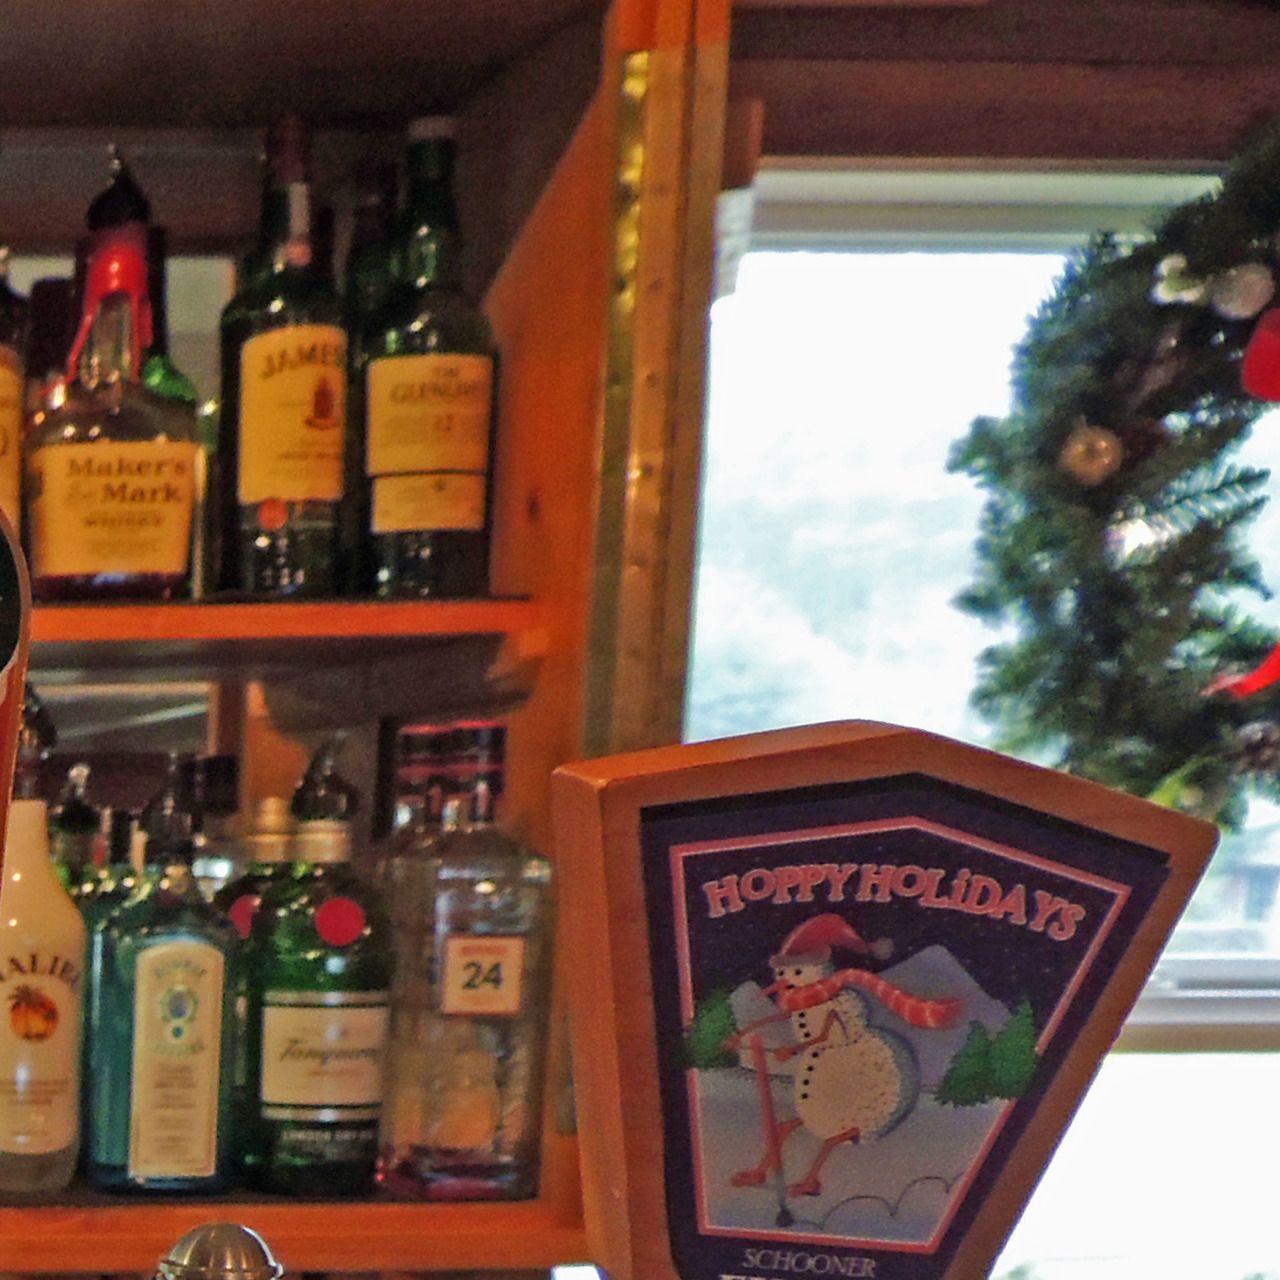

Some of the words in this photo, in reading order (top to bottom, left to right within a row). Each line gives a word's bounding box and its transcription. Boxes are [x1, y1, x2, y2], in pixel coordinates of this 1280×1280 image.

[101, 482, 183, 503] Mark
[701, 861, 857, 920] HOPPY
[461, 961, 505, 991] 24
[741, 1249, 877, 1279] SCHOONER
